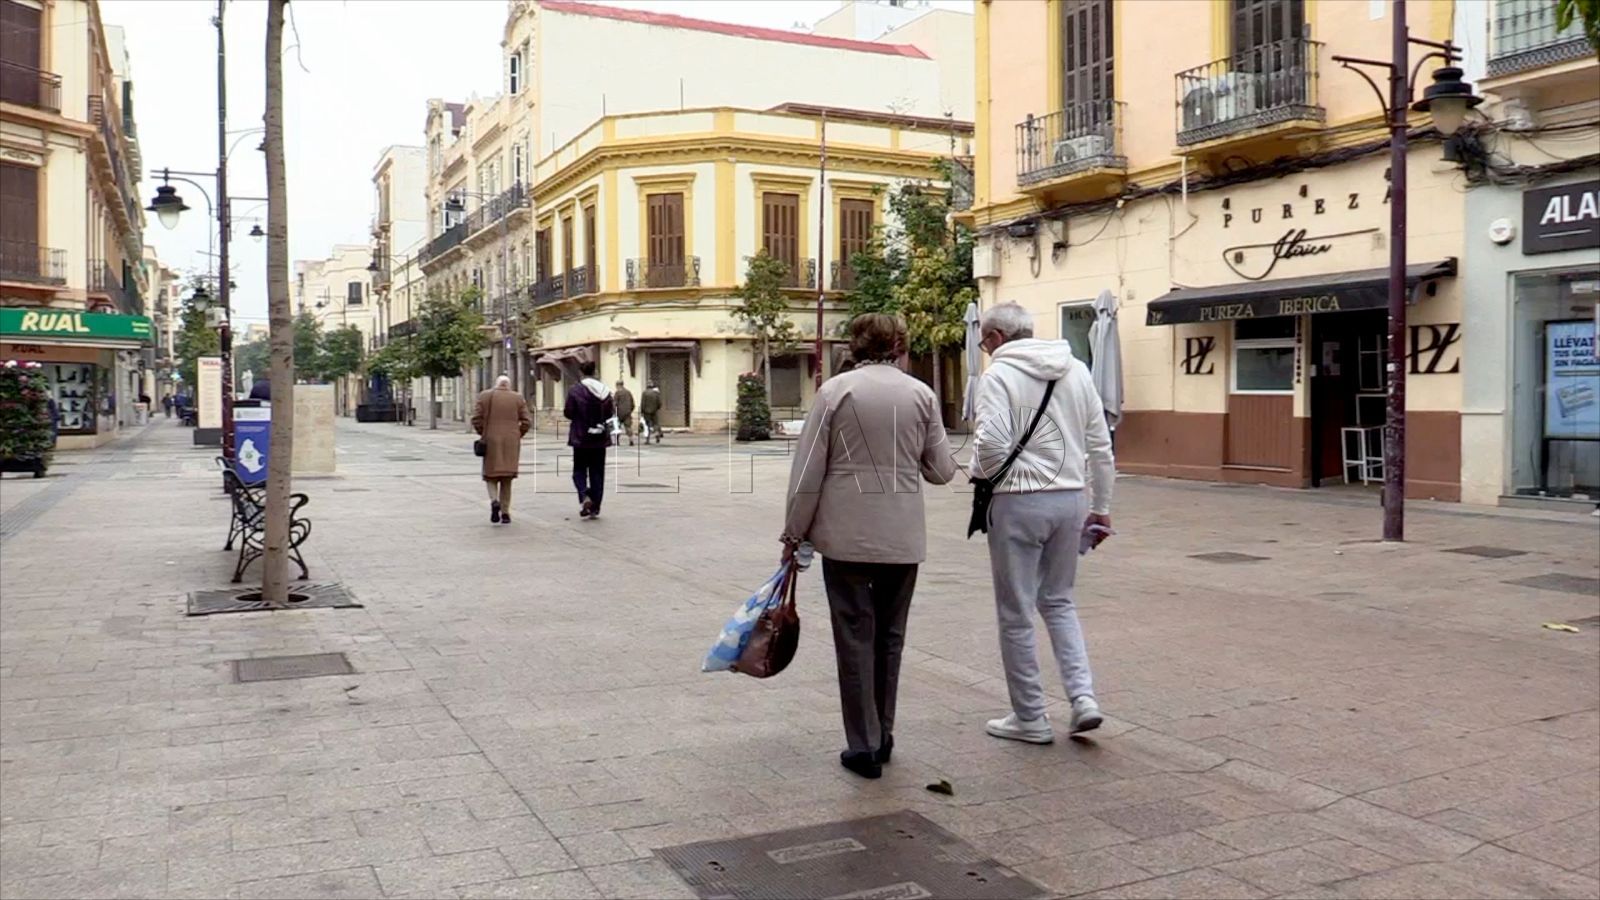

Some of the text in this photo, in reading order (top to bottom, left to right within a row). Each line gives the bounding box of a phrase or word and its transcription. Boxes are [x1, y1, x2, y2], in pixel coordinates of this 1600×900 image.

[1540, 190, 1600, 225] ALA
[1200, 303, 1255, 321] PUREZA
[20, 312, 91, 332] RUAL
[1554, 334, 1595, 348] LLÉVAT
